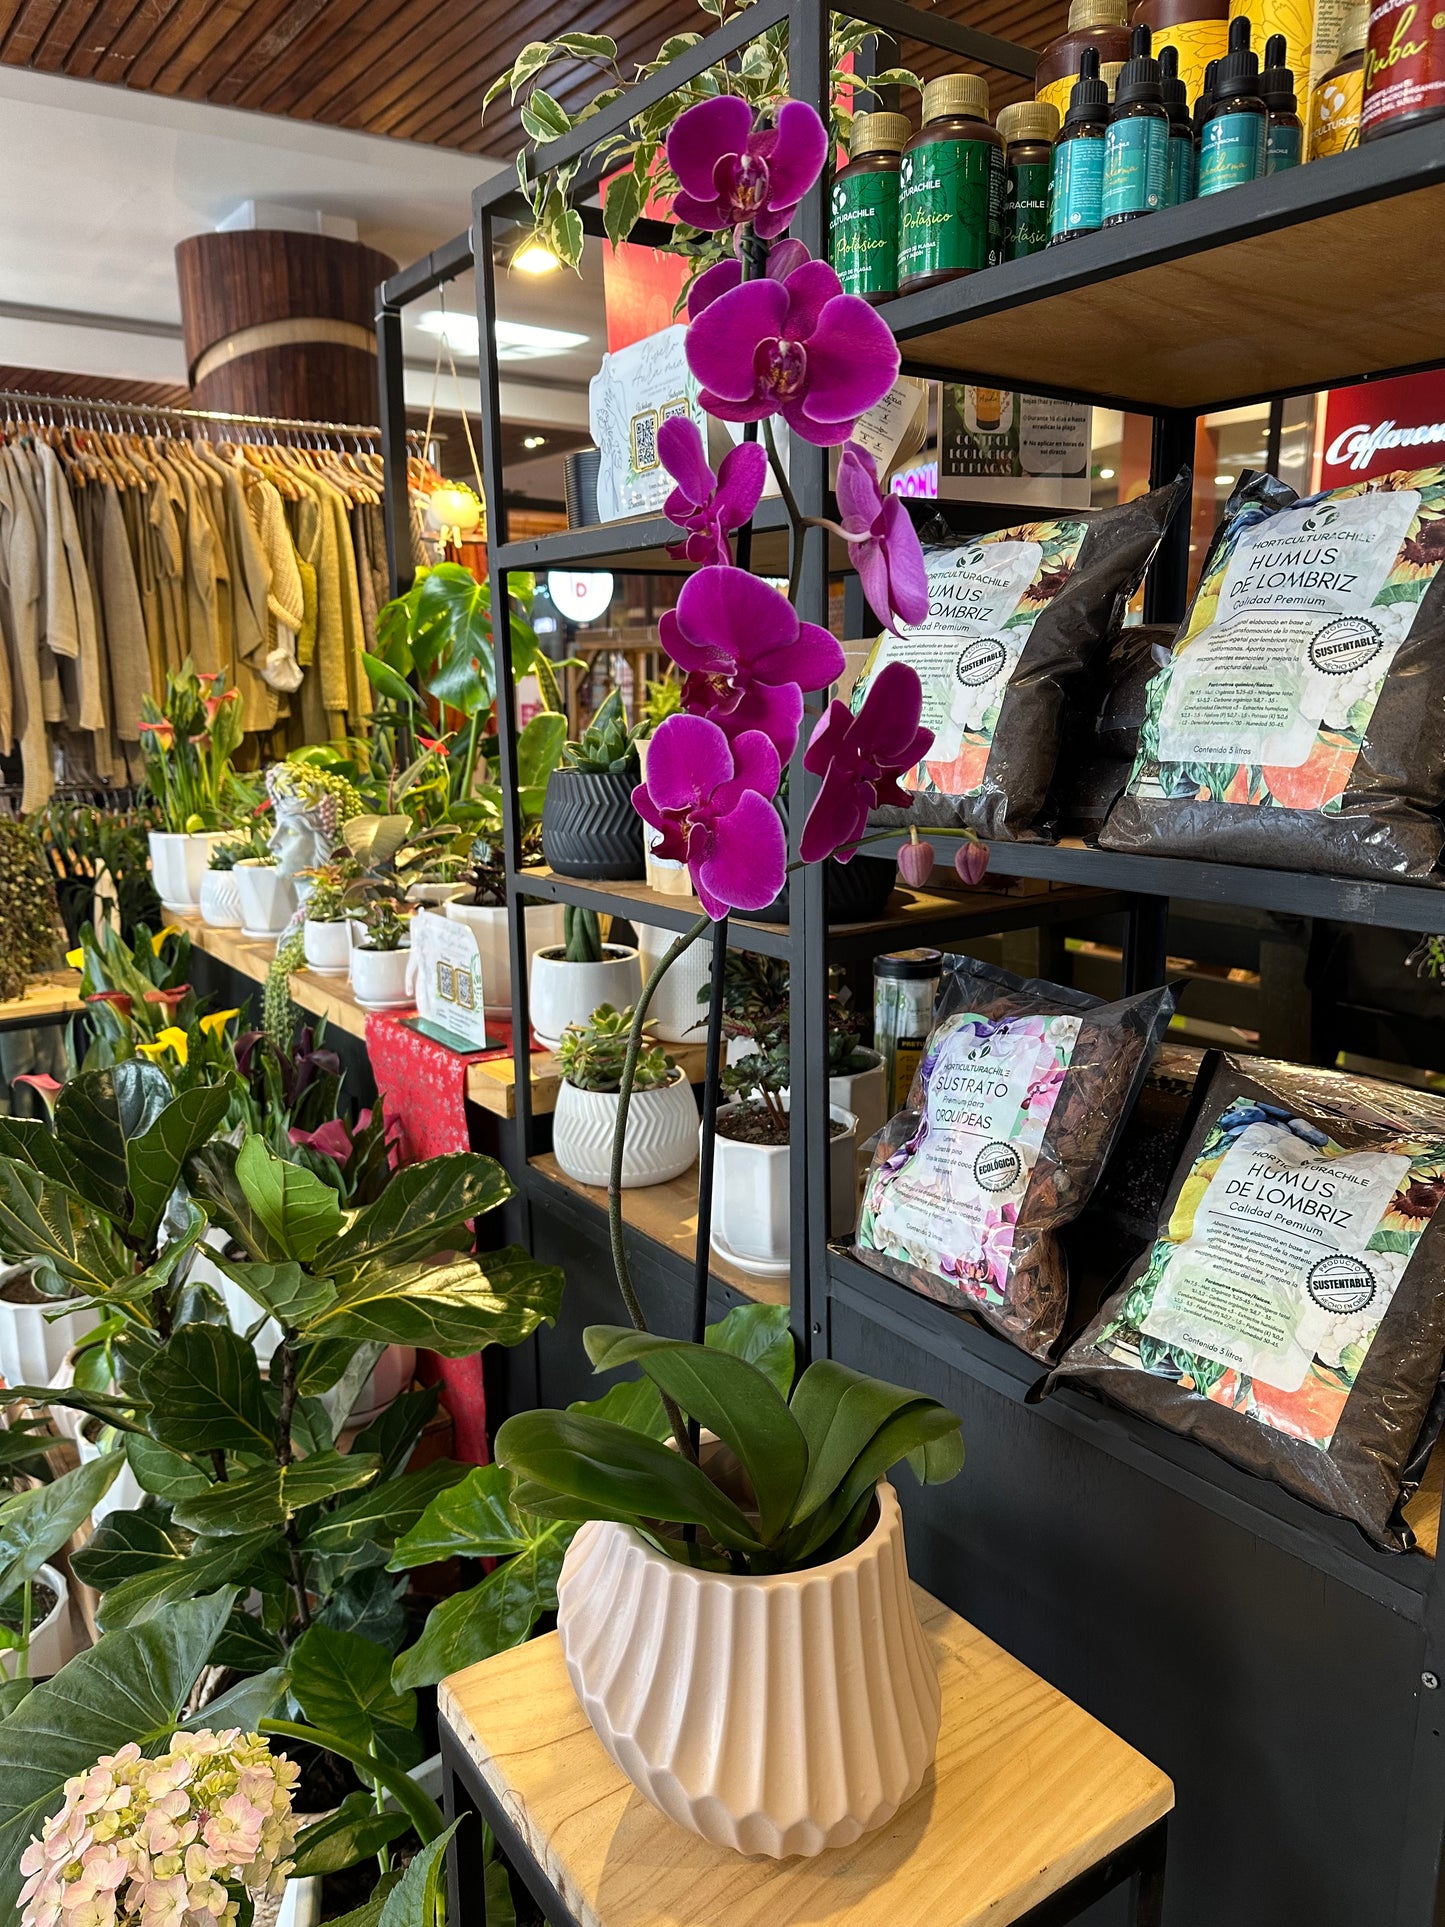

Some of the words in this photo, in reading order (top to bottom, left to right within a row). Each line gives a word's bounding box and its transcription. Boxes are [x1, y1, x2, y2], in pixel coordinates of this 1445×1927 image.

[1365, 4, 1428, 90] Nuba
[903, 206, 953, 236] Potásico
[1002, 222, 1046, 244] Potásic
[837, 232, 887, 260] Potásico
[956, 434, 1009, 446] CONTROL
[969, 462, 1012, 475] PLAGAS
[1252, 531, 1376, 550] HORTICULTURACHILE
[1249, 548, 1338, 571] HUMUS
[928, 571, 1010, 588] ORTICULTURACHILE
[1230, 576, 1254, 598] DE
[1256, 571, 1358, 592] LOMBRIZ
[928, 584, 982, 601] UMUS
[1233, 594, 1272, 610] Calidad
[1274, 595, 1325, 606] Premium
[929, 602, 994, 621] OMBRIZ
[934, 622, 970, 632] Premium
[1321, 621, 1367, 639] PRODUCTO
[1315, 635, 1377, 659] SUSTENTABLE
[960, 650, 1002, 674] SUSTENTABLE
[1194, 745, 1227, 754] Contenido
[1235, 747, 1251, 755] litros
[943, 1063, 1010, 1077] HORTICULTURACHILE
[936, 1076, 1008, 1098] SUSTRATO
[967, 1100, 985, 1108] para
[936, 1107, 993, 1129] ORQUÍDEAS
[958, 1161, 972, 1169] coco
[979, 1157, 1015, 1175] ECOLÓGICO
[1252, 1151, 1370, 1187] HORTICURACHILE
[1247, 1163, 1336, 1198] HUMUS
[1225, 1180, 1254, 1197] DE
[1256, 1185, 1353, 1229] LOMBRIZ
[1229, 1202, 1273, 1219] Calidad
[1274, 1213, 1323, 1236] Premium
[1231, 1233, 1272, 1250] transformación
[1289, 1253, 1312, 1265] materia
[1250, 1231, 1279, 1243] elaborado
[1288, 1243, 1303, 1252] base
[1227, 1241, 1248, 1251] vegetal
[1259, 1250, 1287, 1265] lombrices
[1288, 1262, 1303, 1271] rojas
[1244, 1255, 1264, 1266] Aporta
[1265, 1263, 1284, 1273] macro
[1319, 1260, 1361, 1272] PRODUCTO
[1233, 1261, 1263, 1275] esenciales
[1270, 1274, 1291, 1285] mejora
[1313, 1278, 1371, 1290] SUSTENTABLE
[1183, 1333, 1218, 1353] Contenido
[1225, 1349, 1243, 1363] litros
